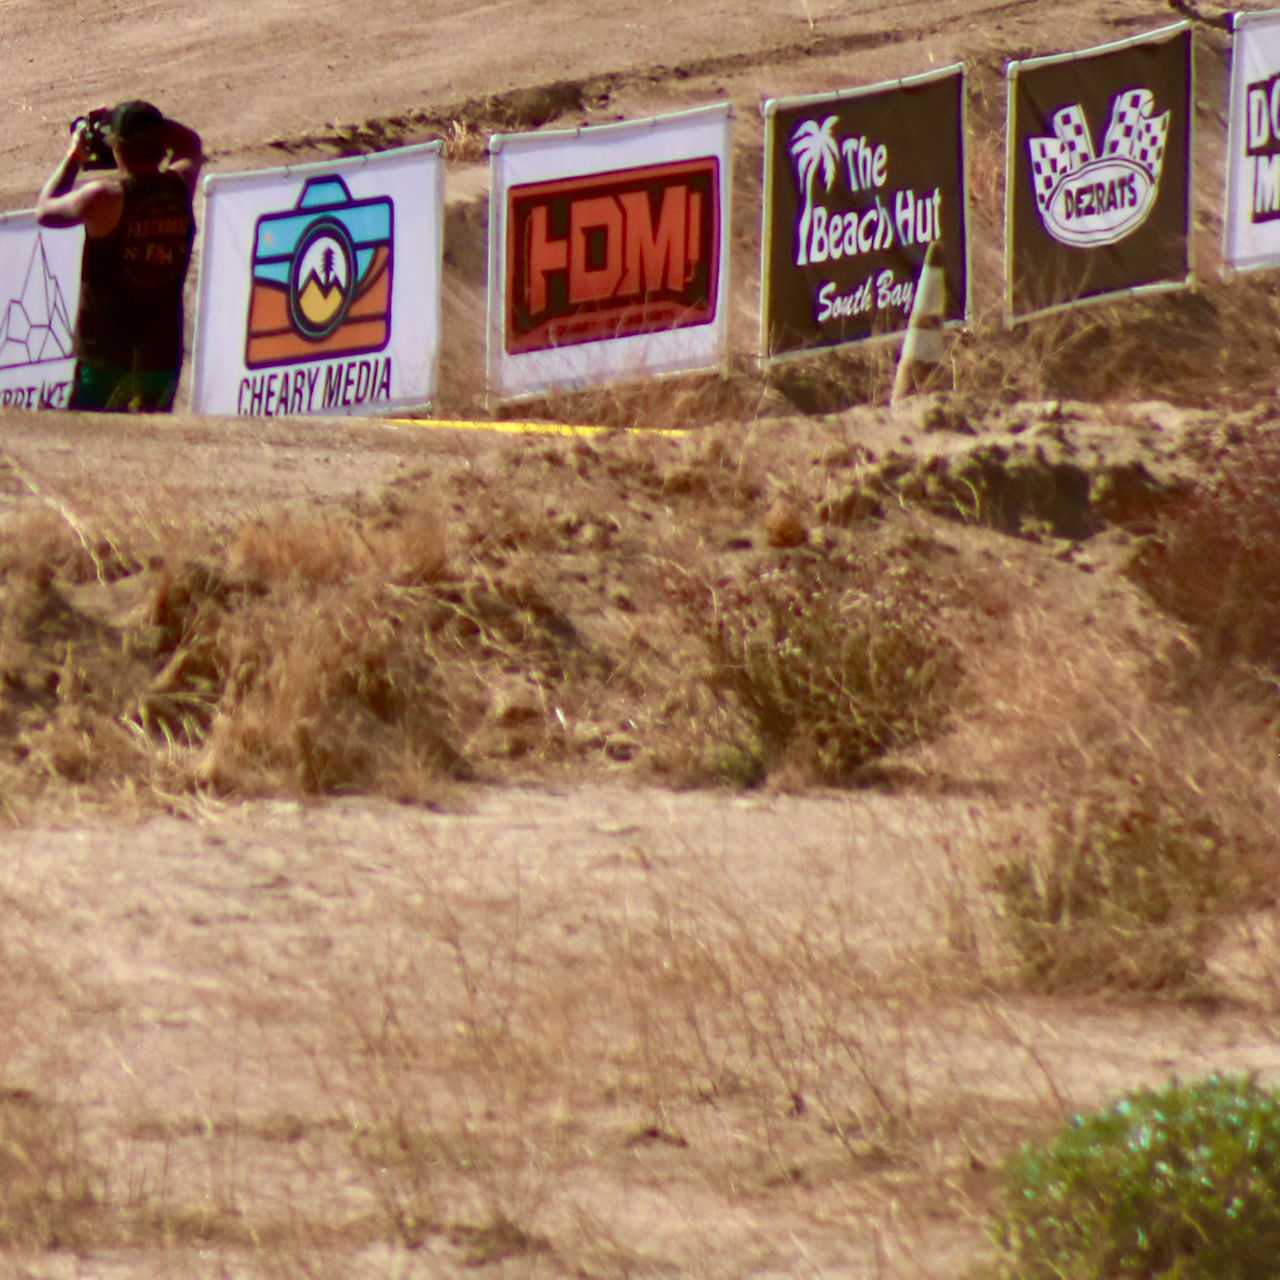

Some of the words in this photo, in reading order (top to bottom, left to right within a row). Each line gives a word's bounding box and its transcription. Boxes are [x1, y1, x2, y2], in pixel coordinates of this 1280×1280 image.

[842, 135, 888, 192] The
[809, 195, 893, 264] Beach
[894, 187, 941, 246] Hut
[817, 276, 873, 323] South
[876, 269, 913, 314] Bay
[238, 366, 320, 417] CHEARY
[322, 357, 392, 409] MEDIA
